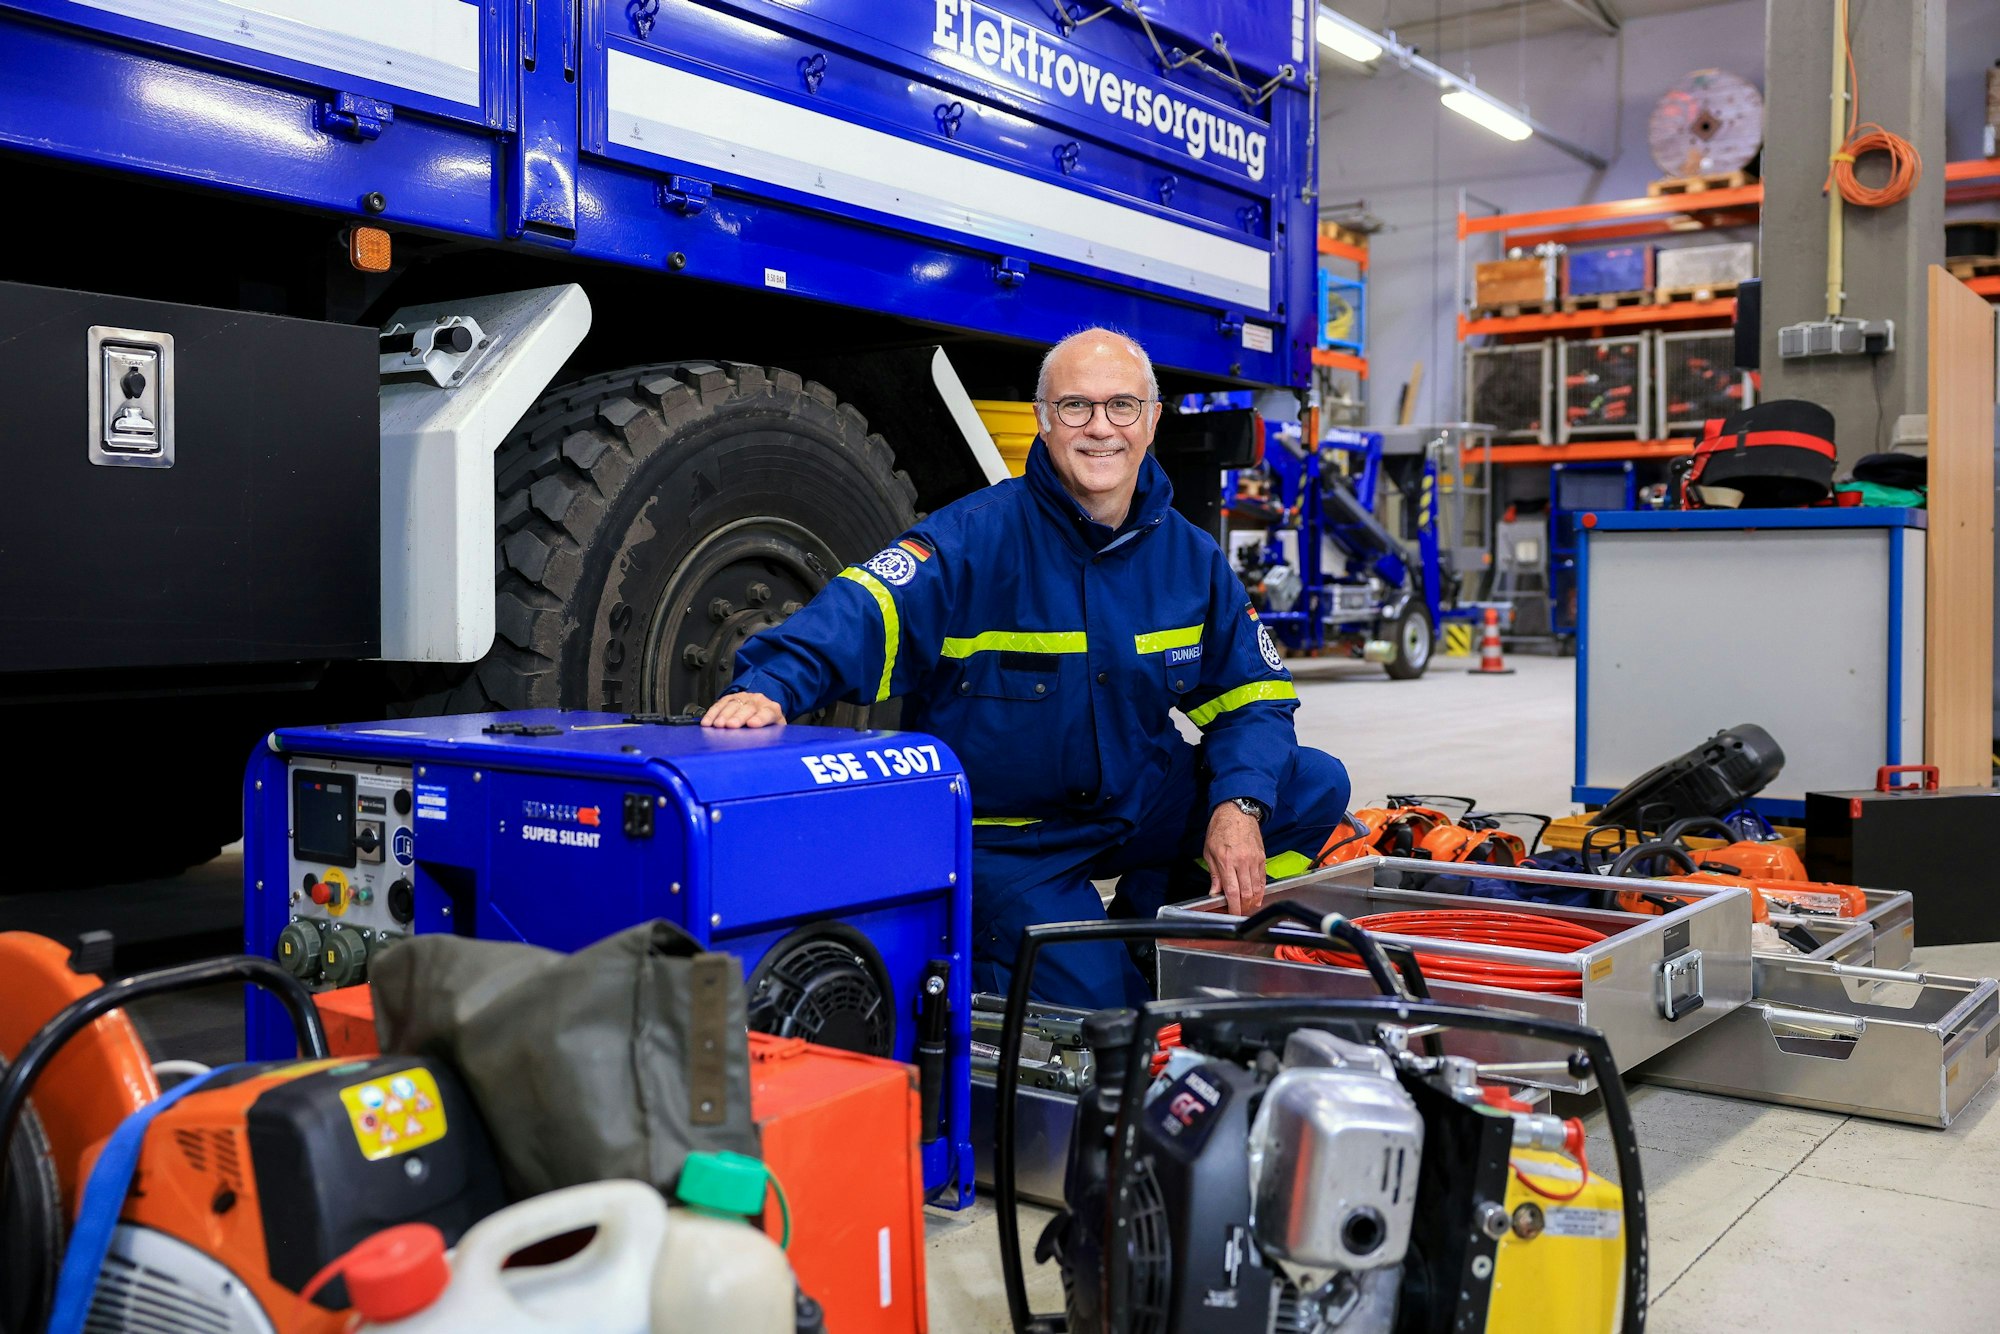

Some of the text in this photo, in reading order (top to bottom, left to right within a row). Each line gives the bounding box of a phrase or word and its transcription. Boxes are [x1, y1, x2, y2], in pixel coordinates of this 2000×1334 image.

[932, 0, 1267, 181] Elektroversorgung
[801, 744, 941, 785] ESE 1307
[522, 825, 601, 849] SUPER SILENT
[1185, 1072, 1221, 1107] HONDA
[1169, 1092, 1205, 1126] GC
